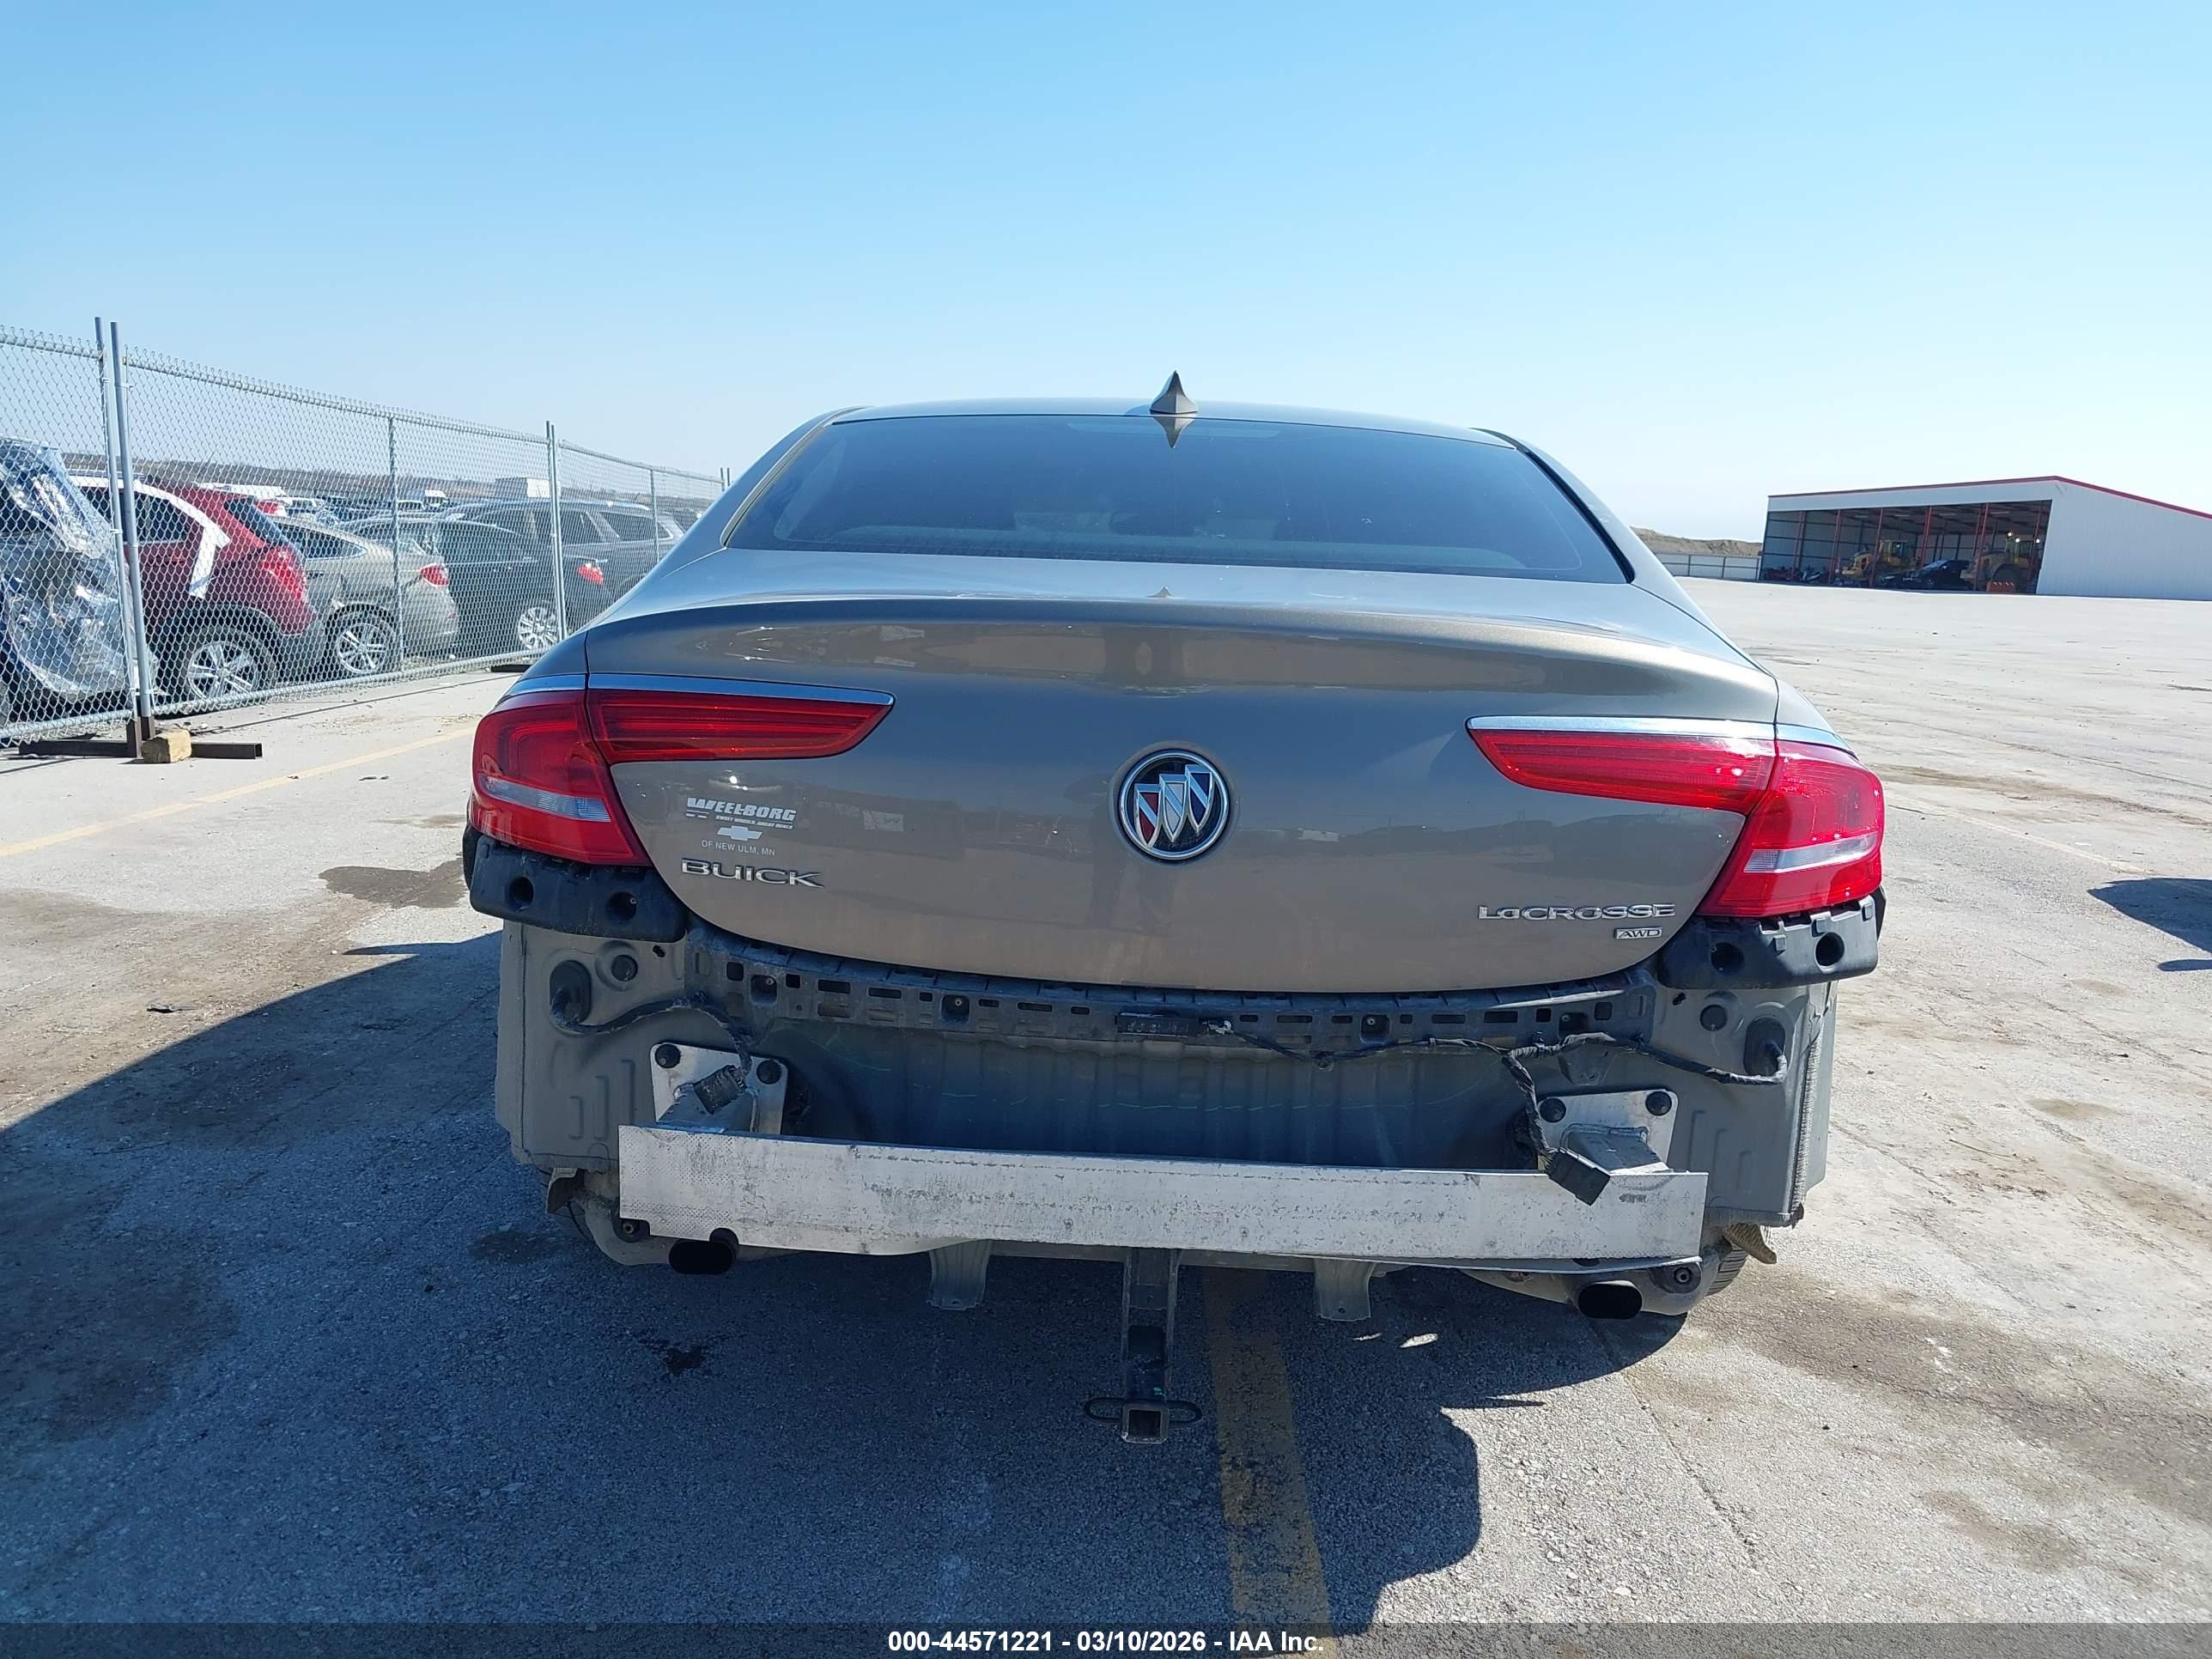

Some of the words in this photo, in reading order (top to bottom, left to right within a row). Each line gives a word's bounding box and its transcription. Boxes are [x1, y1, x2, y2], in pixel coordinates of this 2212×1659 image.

[701, 839, 714, 848] OF
[715, 842, 736, 851] NEW
[761, 847, 775, 856] MN
[681, 858, 825, 889] BUICK
[1617, 927, 1662, 939] AWD
